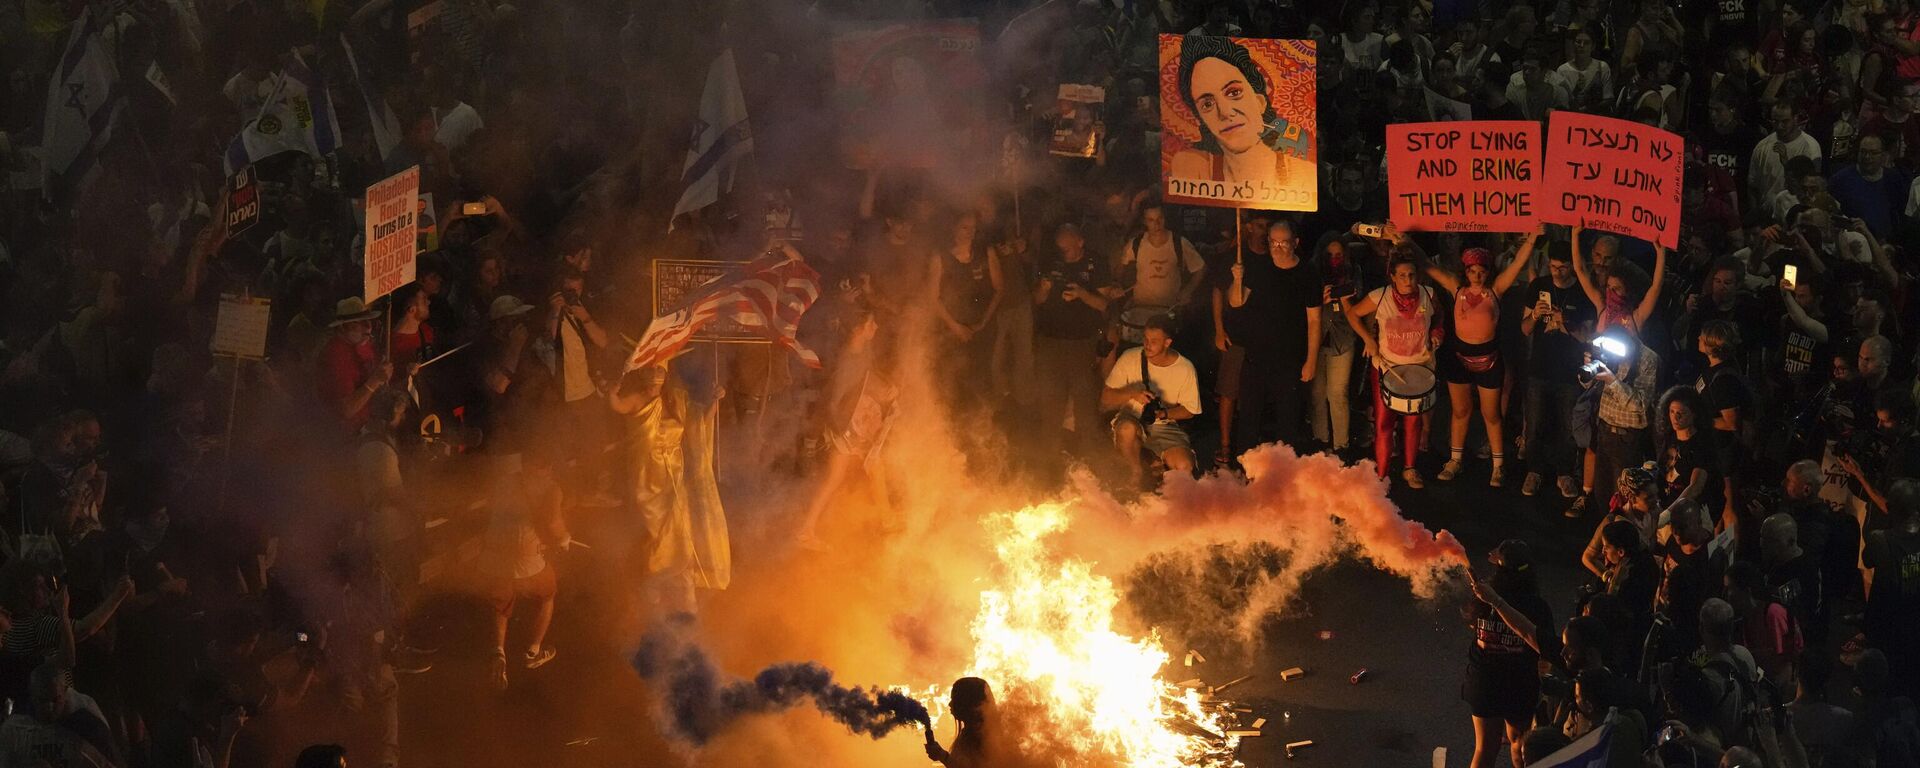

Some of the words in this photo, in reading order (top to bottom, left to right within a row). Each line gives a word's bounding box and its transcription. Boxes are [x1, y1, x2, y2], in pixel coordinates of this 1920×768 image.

[1407, 131, 1460, 151] STOP
[1471, 131, 1527, 150] LYING
[1568, 126, 1639, 152] תעצרו
[1651, 140, 1673, 162] לא
[1417, 159, 1457, 179] AND
[1471, 158, 1531, 181] BRING
[1566, 162, 1601, 180] עד
[1614, 168, 1662, 196] אותנו
[1171, 179, 1225, 197] תחזור
[1232, 180, 1254, 199] לא
[380, 197, 407, 221] Route
[1400, 192, 1465, 216] THEM
[1473, 191, 1531, 216] HOME
[1562, 192, 1620, 217] חוזרים
[373, 221, 396, 241] Turns
[398, 214, 406, 231] to
[407, 212, 413, 225] a
[1632, 206, 1667, 231] שהם
[370, 226, 415, 262] HOSTAGES
[371, 255, 394, 281] DEAD
[396, 245, 412, 268] END
[378, 268, 403, 295] ISSUE
